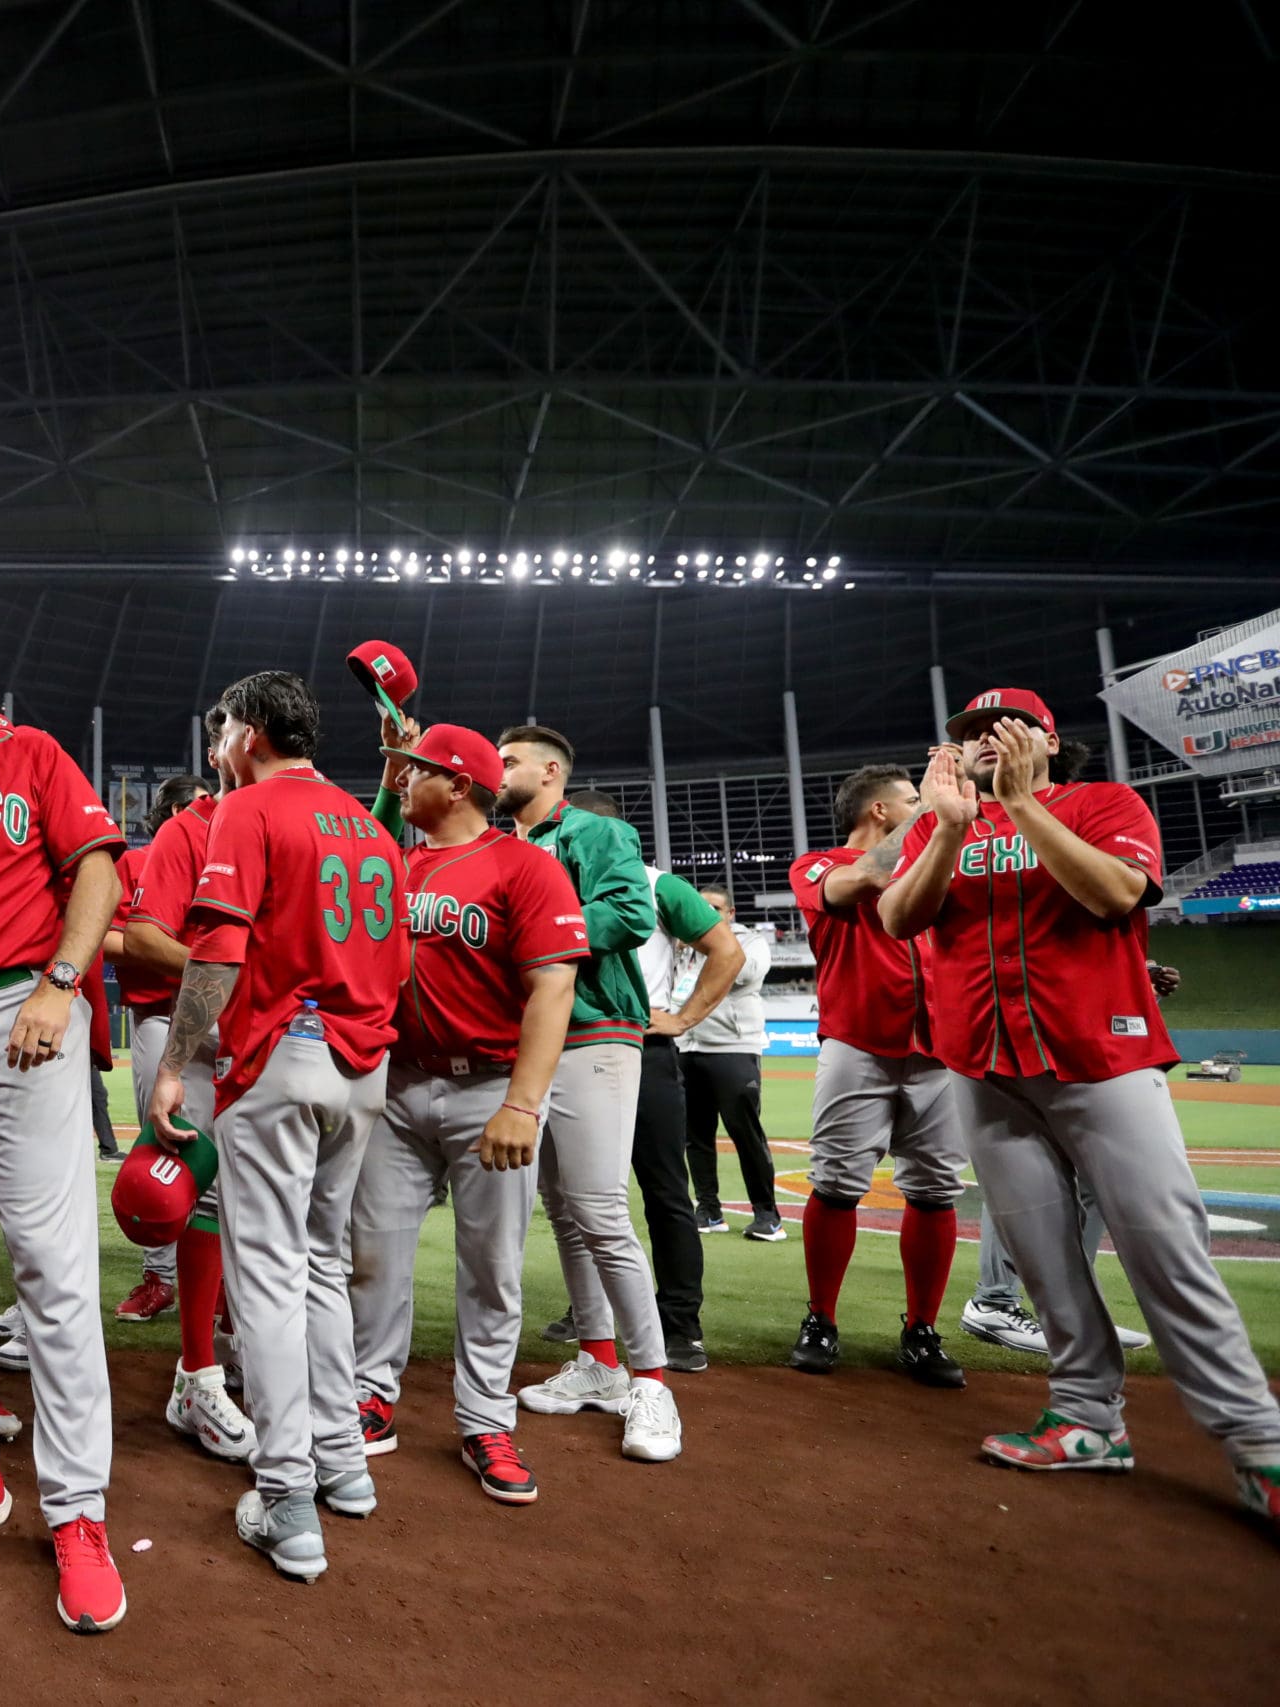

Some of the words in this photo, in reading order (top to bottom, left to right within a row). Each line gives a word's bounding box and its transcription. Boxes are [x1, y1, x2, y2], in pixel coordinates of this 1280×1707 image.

[313, 812, 379, 840] REYES
[950, 834, 1039, 878] EXI
[320, 854, 394, 943] 33
